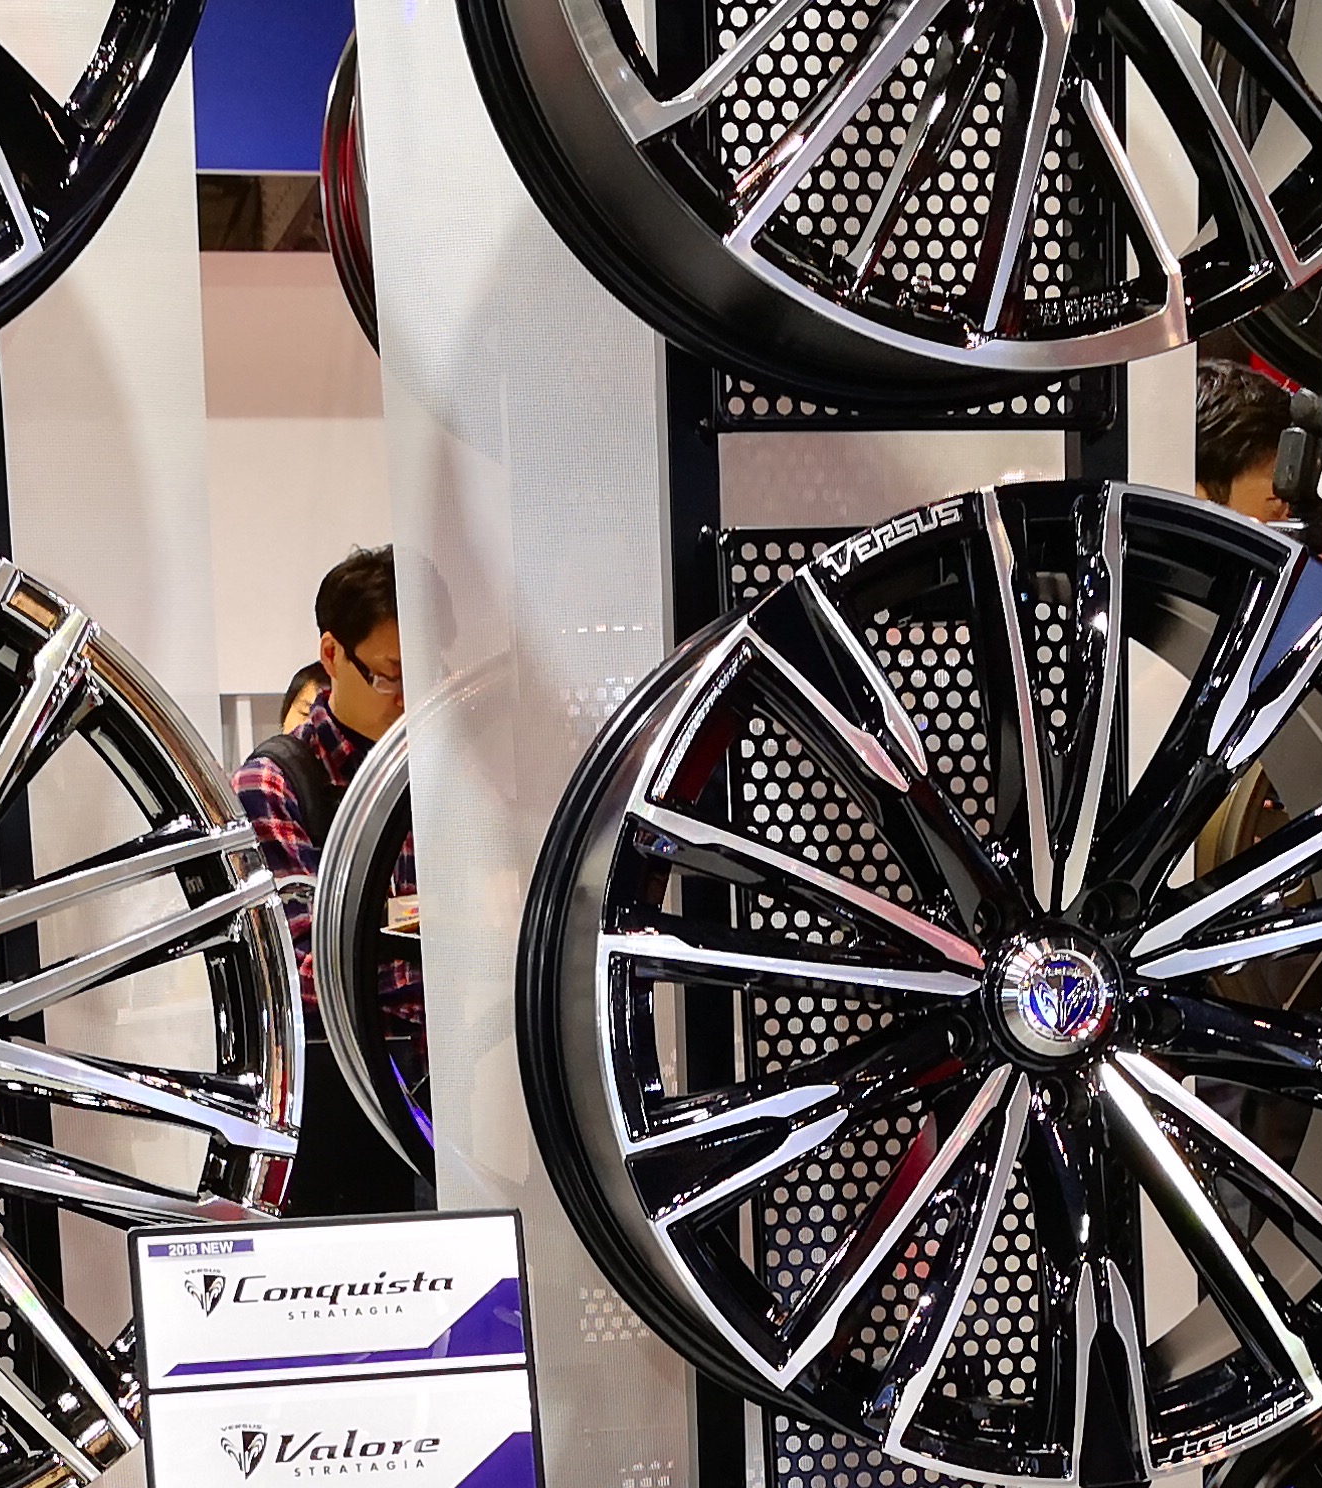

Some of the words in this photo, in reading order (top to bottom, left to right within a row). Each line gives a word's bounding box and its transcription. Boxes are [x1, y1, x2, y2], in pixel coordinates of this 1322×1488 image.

[816, 497, 963, 579] VERSUS
[168, 1243, 198, 1256] 2018
[201, 1241, 234, 1254] NEW
[184, 1268, 222, 1276] VERSUS
[233, 1270, 453, 1305] Conquista
[288, 1305, 404, 1321] STRATAGIA
[220, 1423, 263, 1432] VERSUS
[275, 1430, 440, 1463] Valore
[294, 1459, 425, 1477] STRATAGIA
